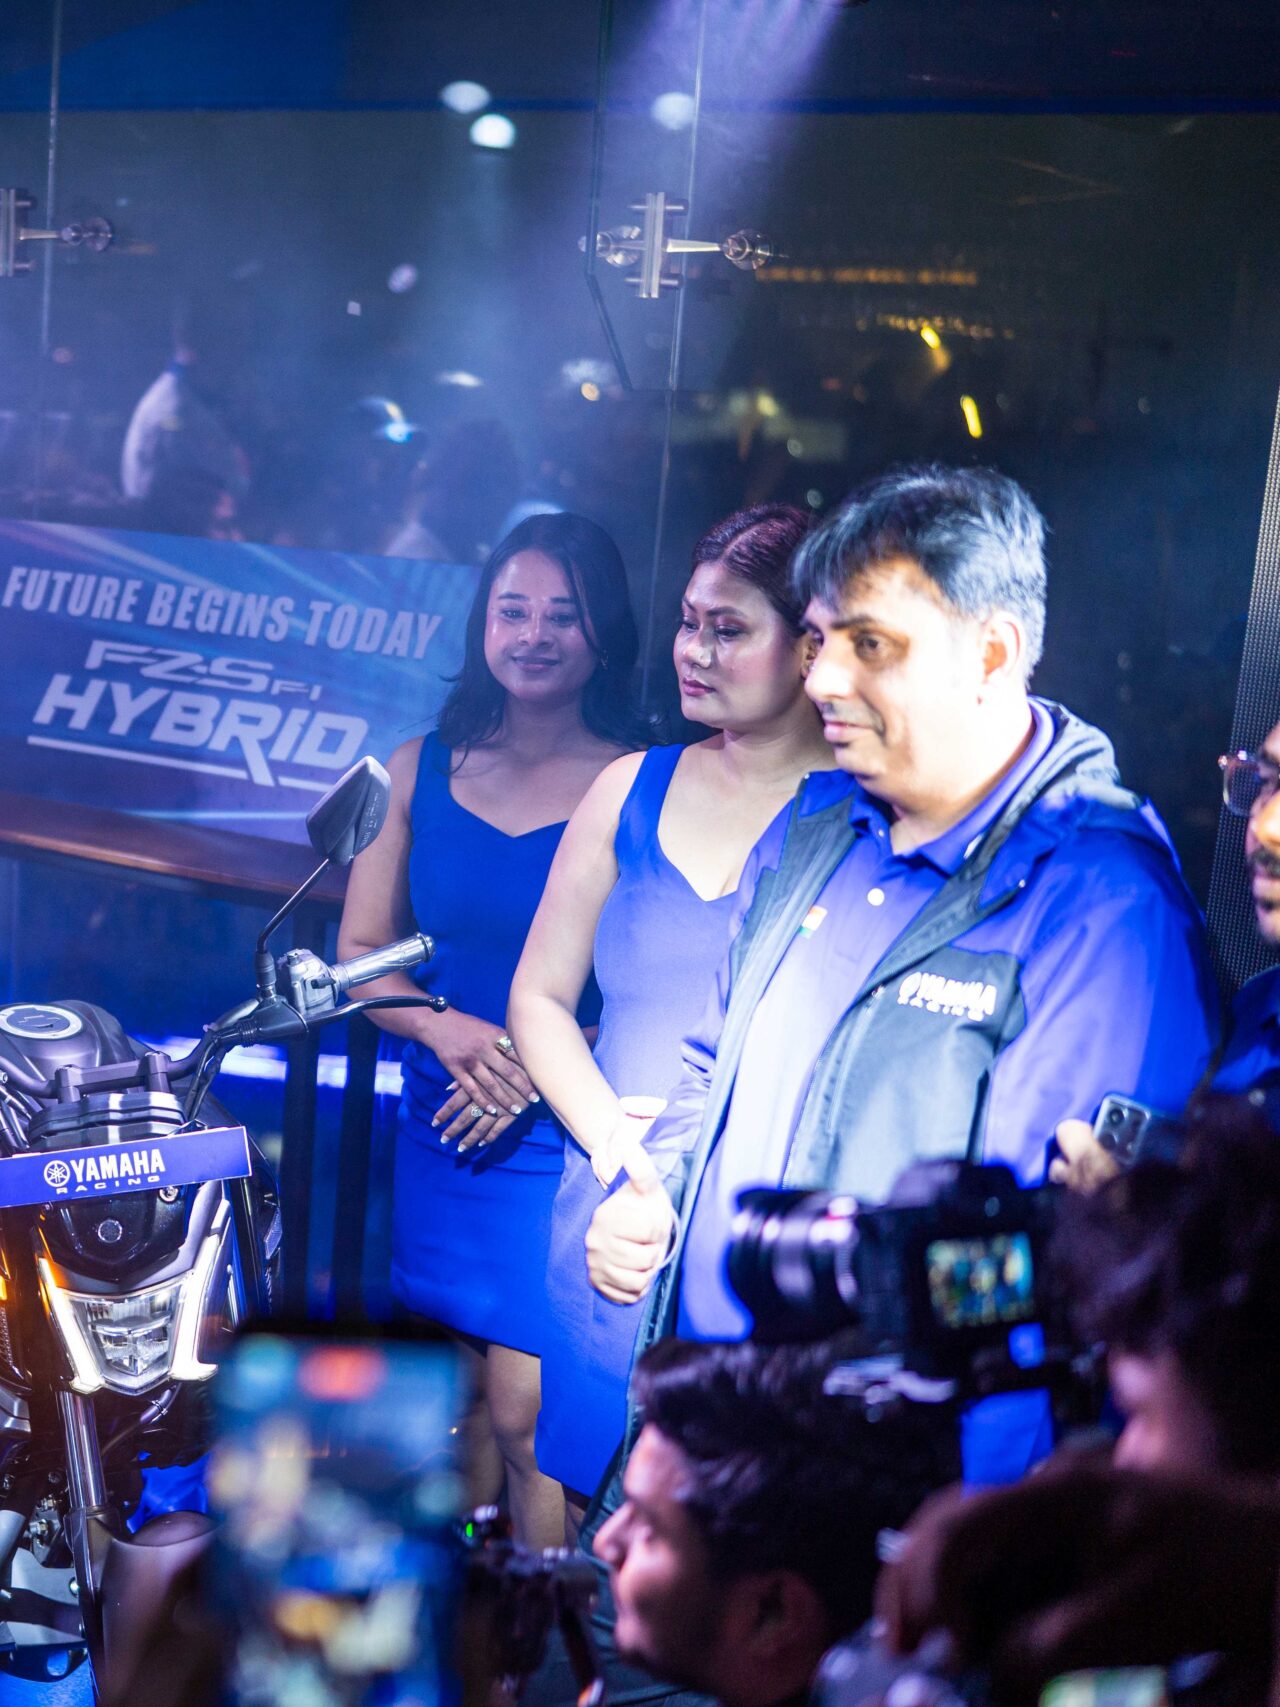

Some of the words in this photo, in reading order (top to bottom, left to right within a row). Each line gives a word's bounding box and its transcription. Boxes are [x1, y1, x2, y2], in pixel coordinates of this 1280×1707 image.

[2, 566, 143, 622] FUTURE
[146, 582, 294, 642] BEGINS
[304, 600, 442, 660] TODAY
[32, 673, 369, 787] HYBRID
[55, 1175, 161, 1195] RACING
[69, 1148, 166, 1183] YAMAHA
